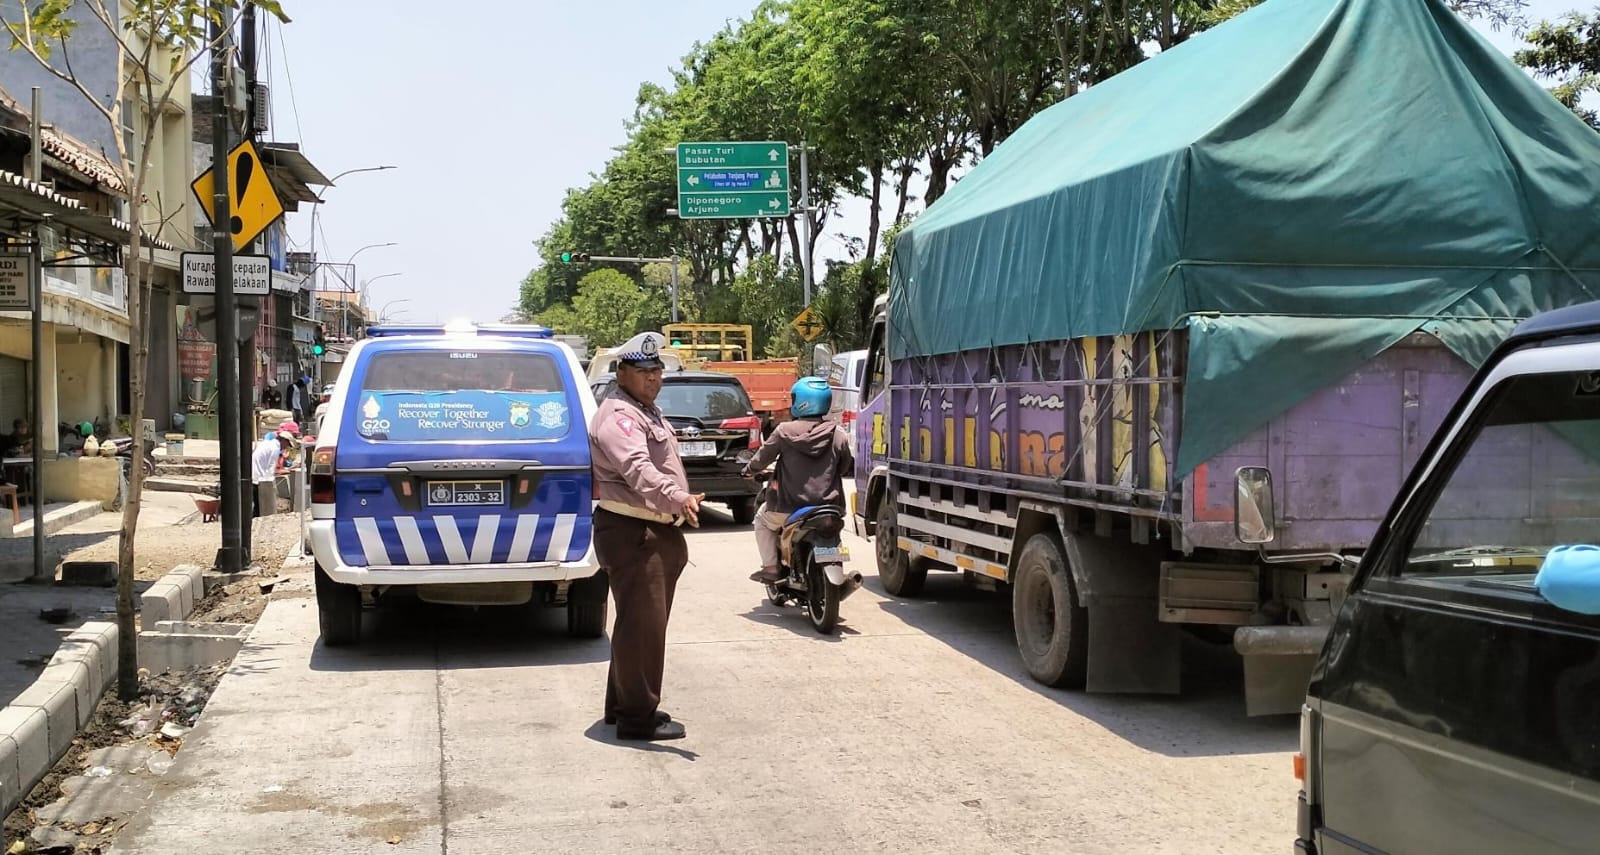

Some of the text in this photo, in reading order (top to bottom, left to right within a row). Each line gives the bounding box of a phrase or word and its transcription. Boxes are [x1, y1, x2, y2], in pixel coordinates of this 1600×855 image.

[687, 197, 741, 205] Diponegoro
[688, 206, 719, 214] Arjuno
[186, 260, 216, 275] Kurang
[187, 275, 215, 287] Rawan
[441, 402, 474, 410] Presidency
[398, 409, 489, 421] Recover Together
[362, 419, 390, 430] G20
[418, 419, 505, 431] Recover Stronger
[457, 493, 480, 502] 2303
[487, 493, 499, 501] 32
